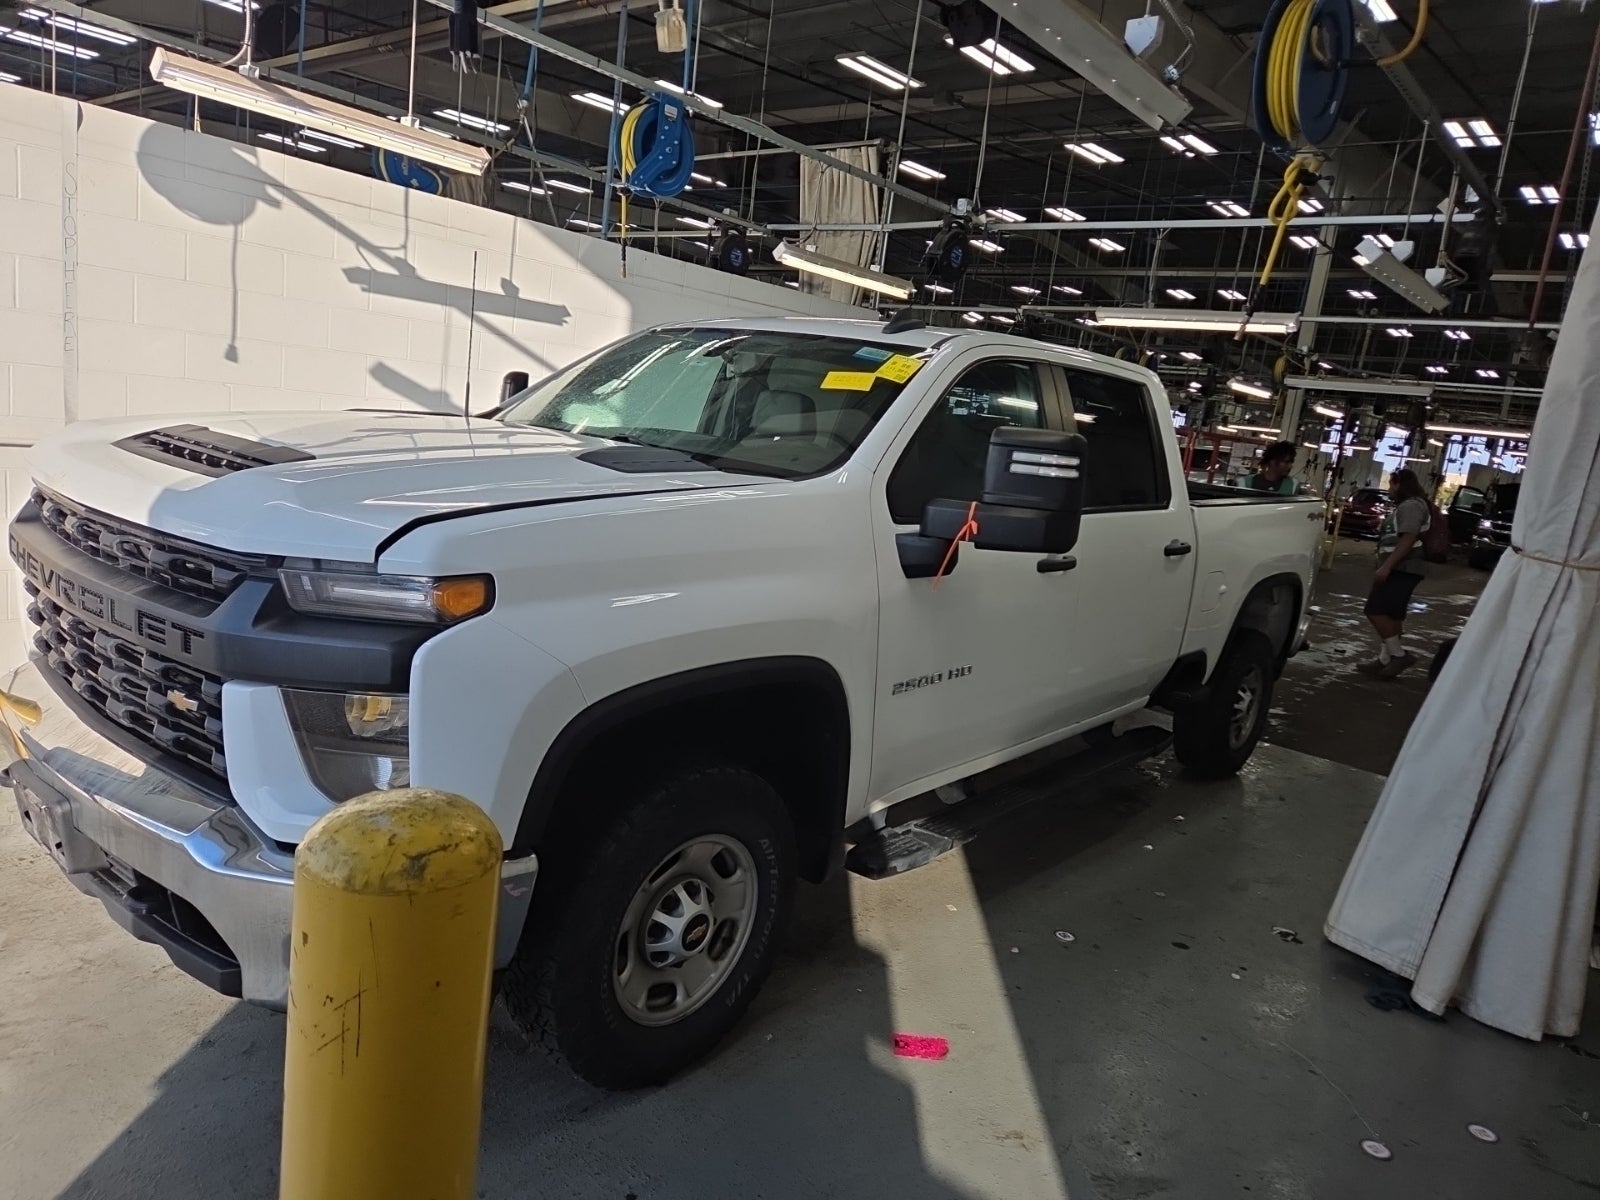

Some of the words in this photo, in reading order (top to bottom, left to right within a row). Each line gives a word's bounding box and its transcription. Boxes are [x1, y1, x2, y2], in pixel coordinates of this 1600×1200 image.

[9, 532, 205, 655] CHEVROLET
[891, 672, 943, 696] 2500
[947, 663, 973, 680] HD
